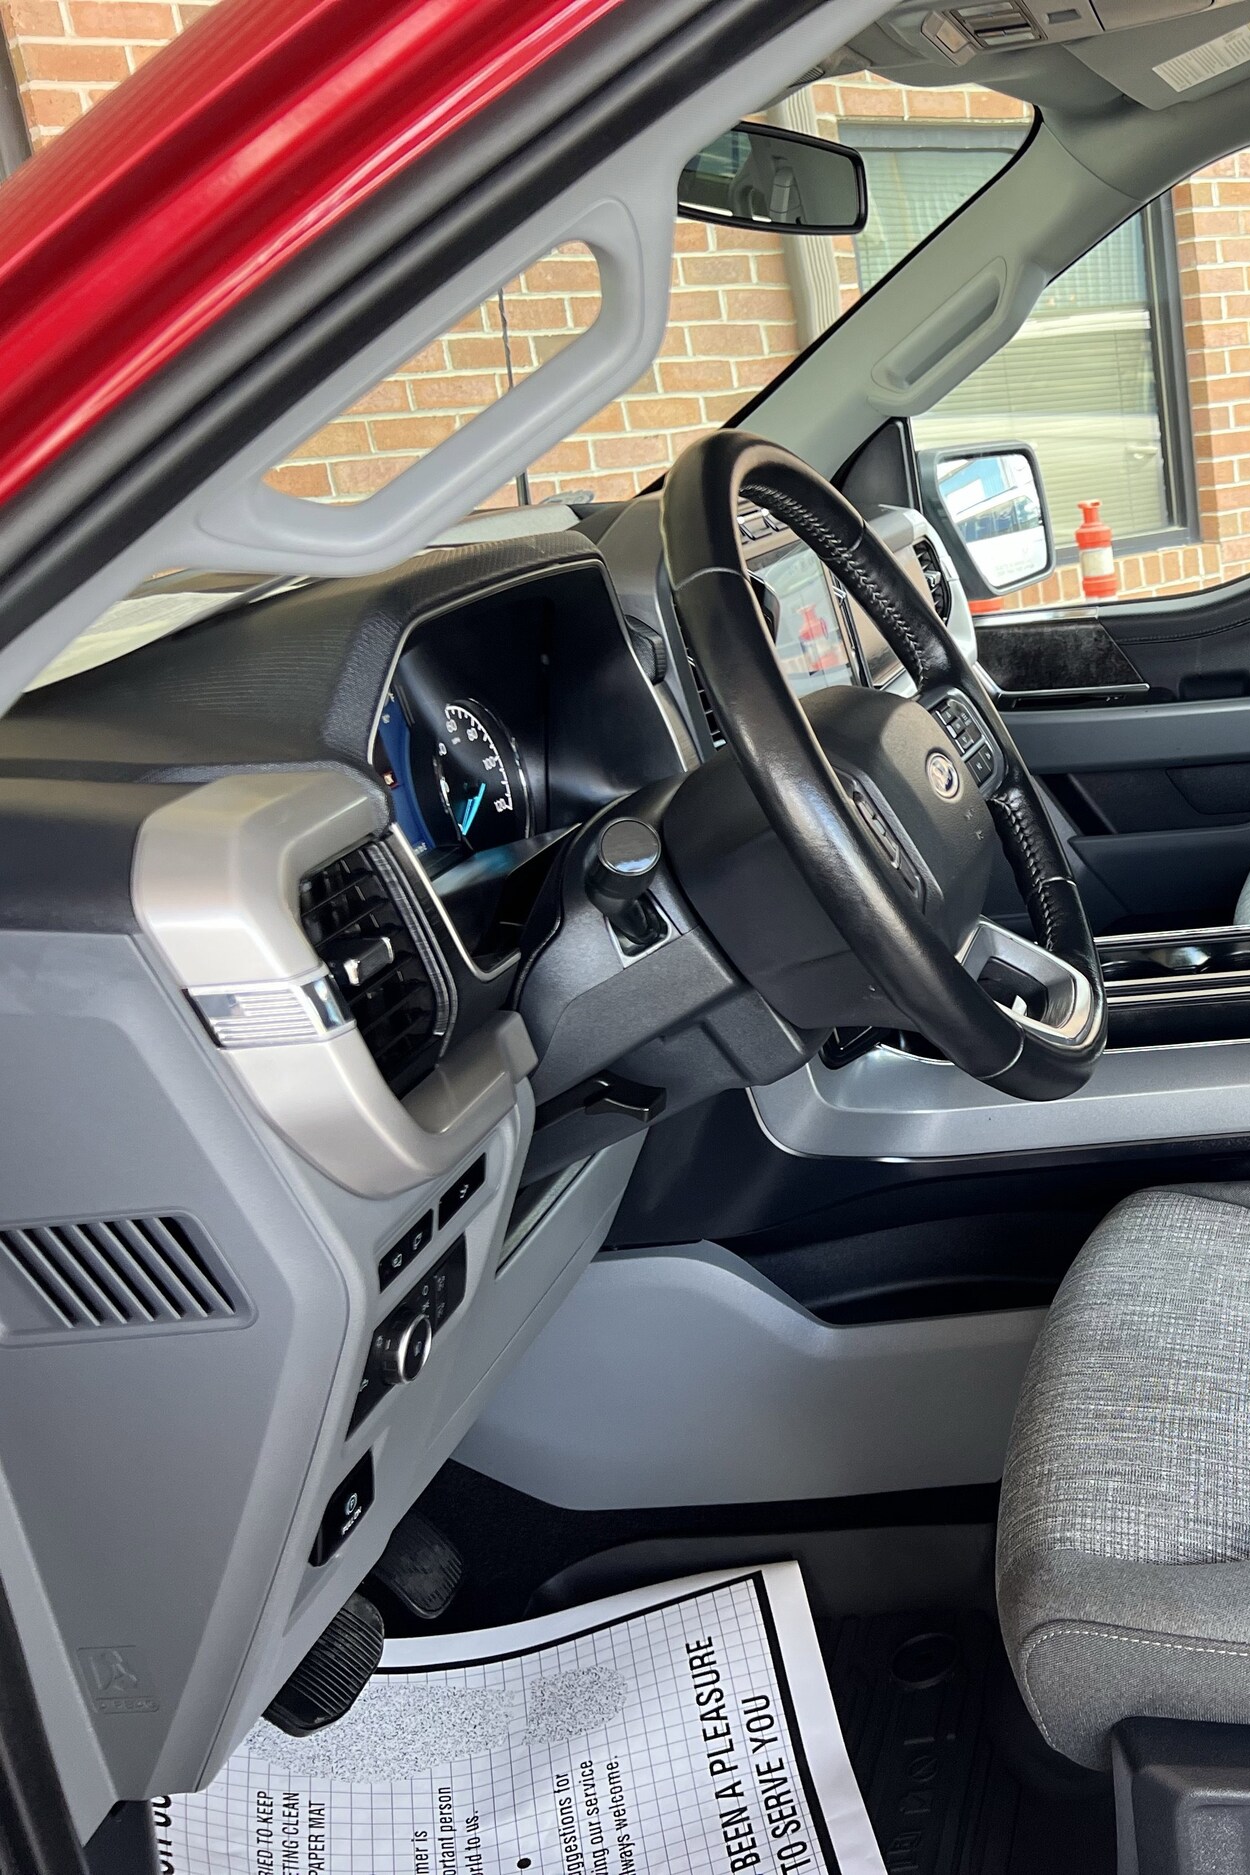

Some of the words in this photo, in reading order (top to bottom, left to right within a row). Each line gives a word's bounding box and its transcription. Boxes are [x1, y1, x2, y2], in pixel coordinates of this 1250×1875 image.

[685, 1635, 739, 1778] PLEASURE
[741, 1694, 779, 1754] YOU
[553, 1773, 570, 1794] for
[578, 1759, 600, 1817] service
[606, 1755, 628, 1832] welcome.
[714, 1779, 744, 1800] A
[755, 1757, 801, 1840] SERVE
[256, 1791, 273, 1824] KEEP
[282, 1792, 299, 1835] CLEAN
[308, 1800, 326, 1829] MAT
[437, 1786, 457, 1834] person
[465, 1809, 480, 1834] us.
[256, 1827, 274, 1845] TO
[411, 1830, 428, 1843] is
[466, 1837, 481, 1850] to
[587, 1821, 604, 1845] our
[719, 1805, 761, 1873] BEEN
[414, 1847, 429, 1875] mer
[438, 1837, 455, 1875] ortant
[617, 1834, 636, 1875] lways
[777, 1840, 811, 1875] TO
